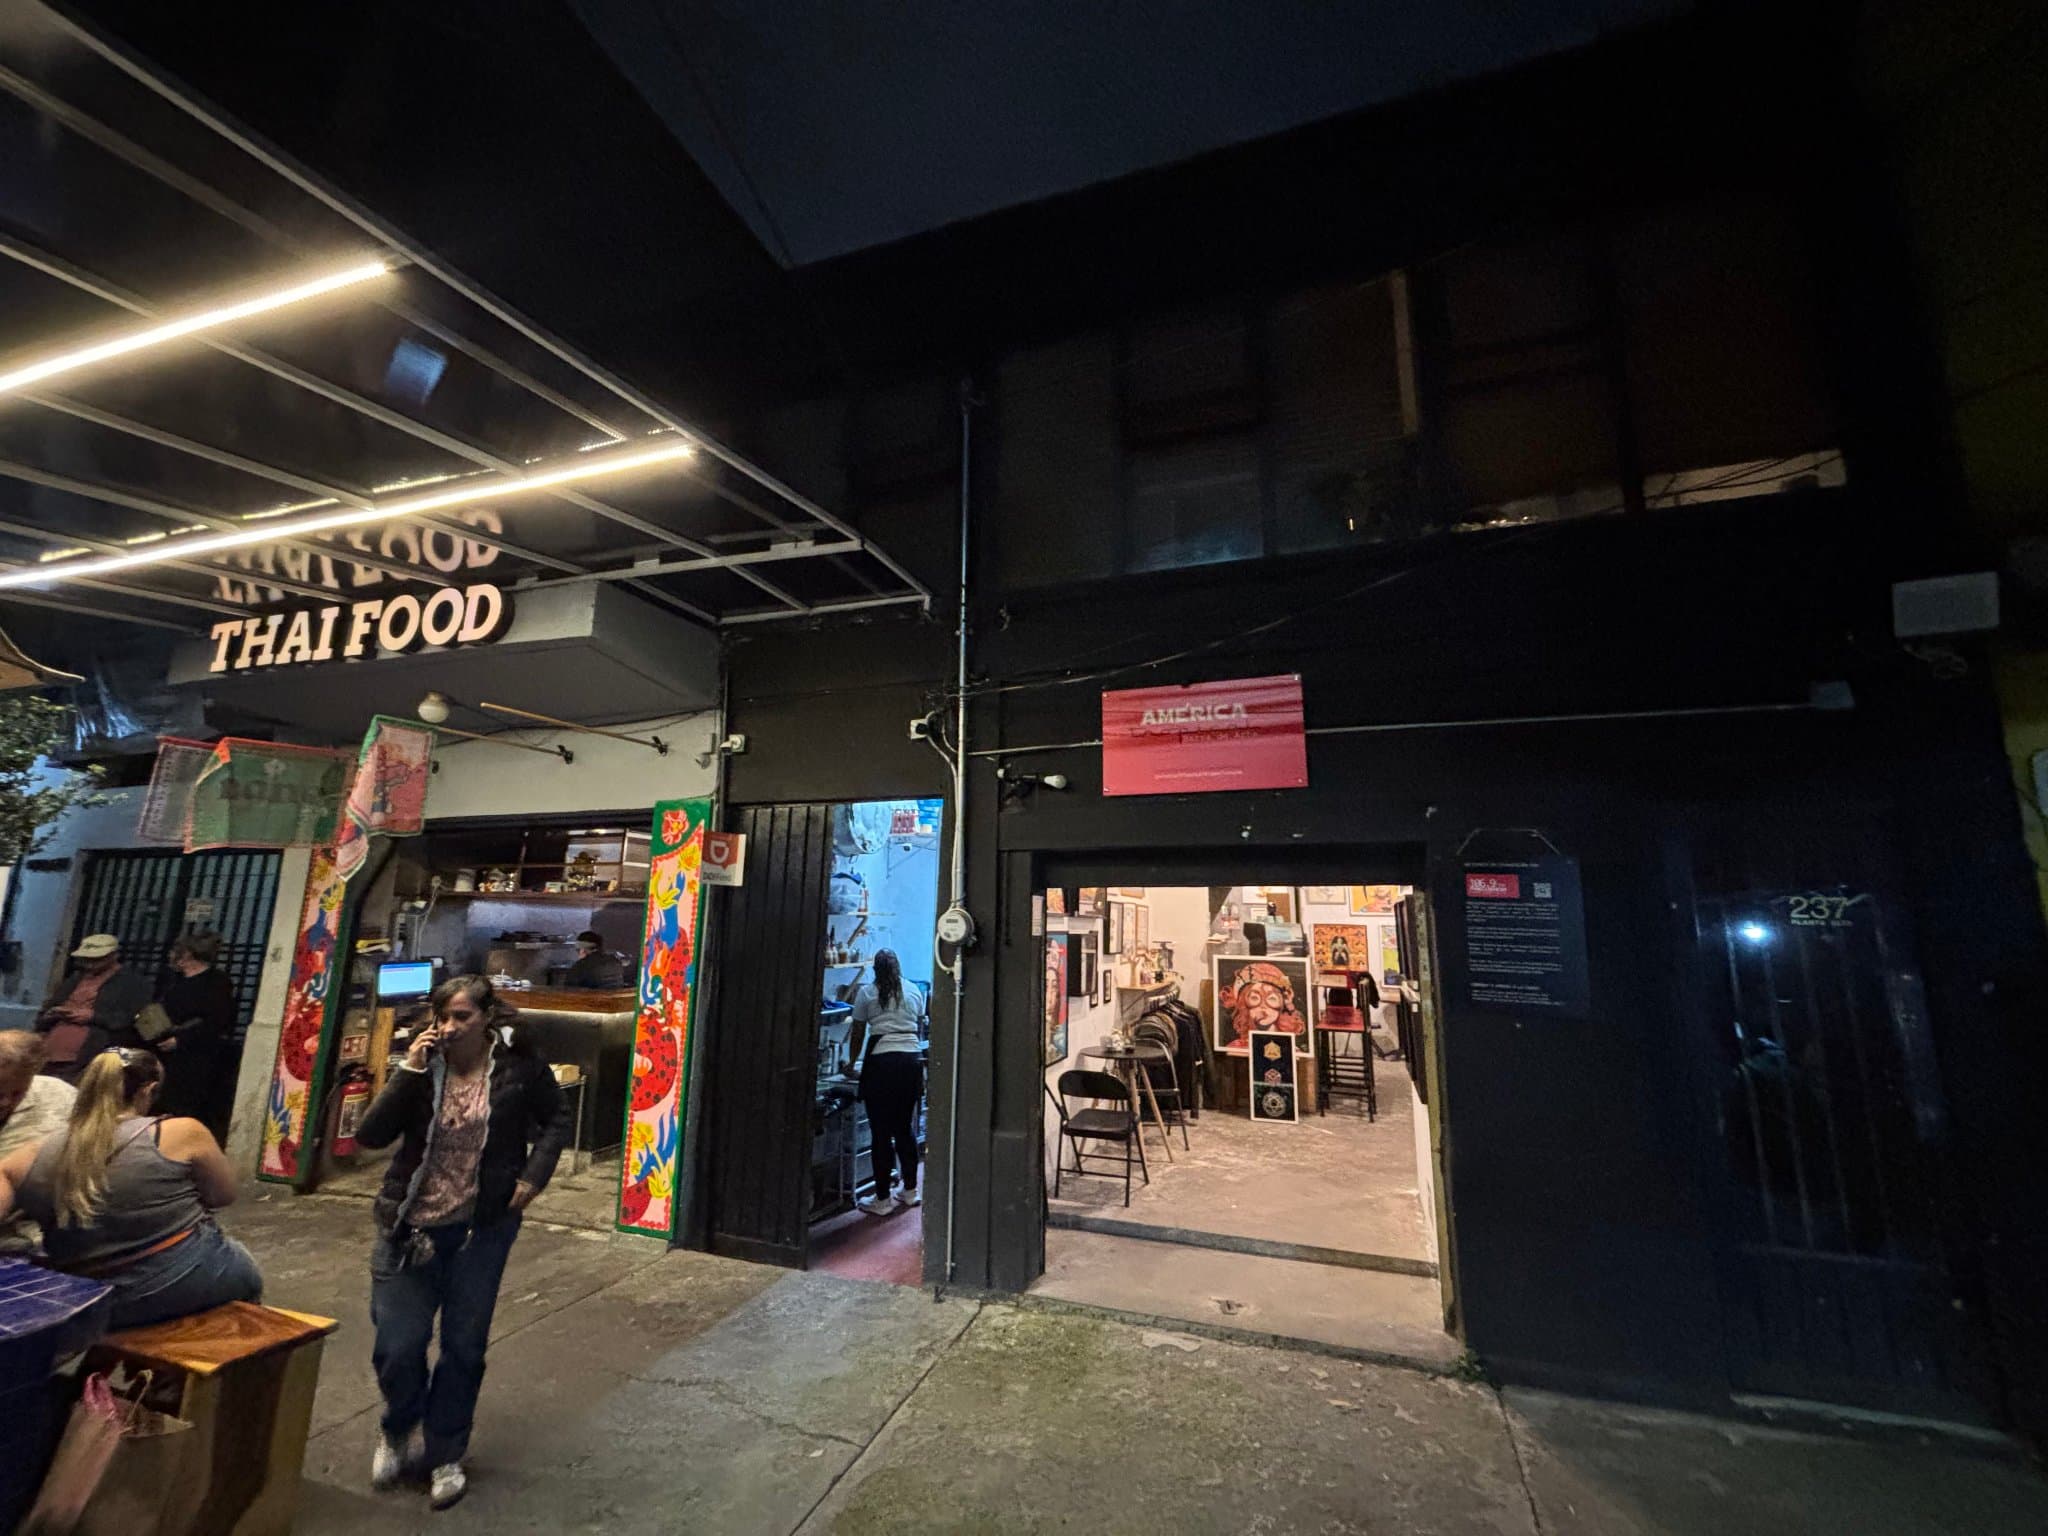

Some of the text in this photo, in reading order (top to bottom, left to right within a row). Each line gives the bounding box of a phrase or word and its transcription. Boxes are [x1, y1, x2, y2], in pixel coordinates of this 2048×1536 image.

[209, 583, 503, 673] THAI FOOD
[1140, 702, 1249, 727] AMÉRICA
[1788, 896, 1849, 919] 237
